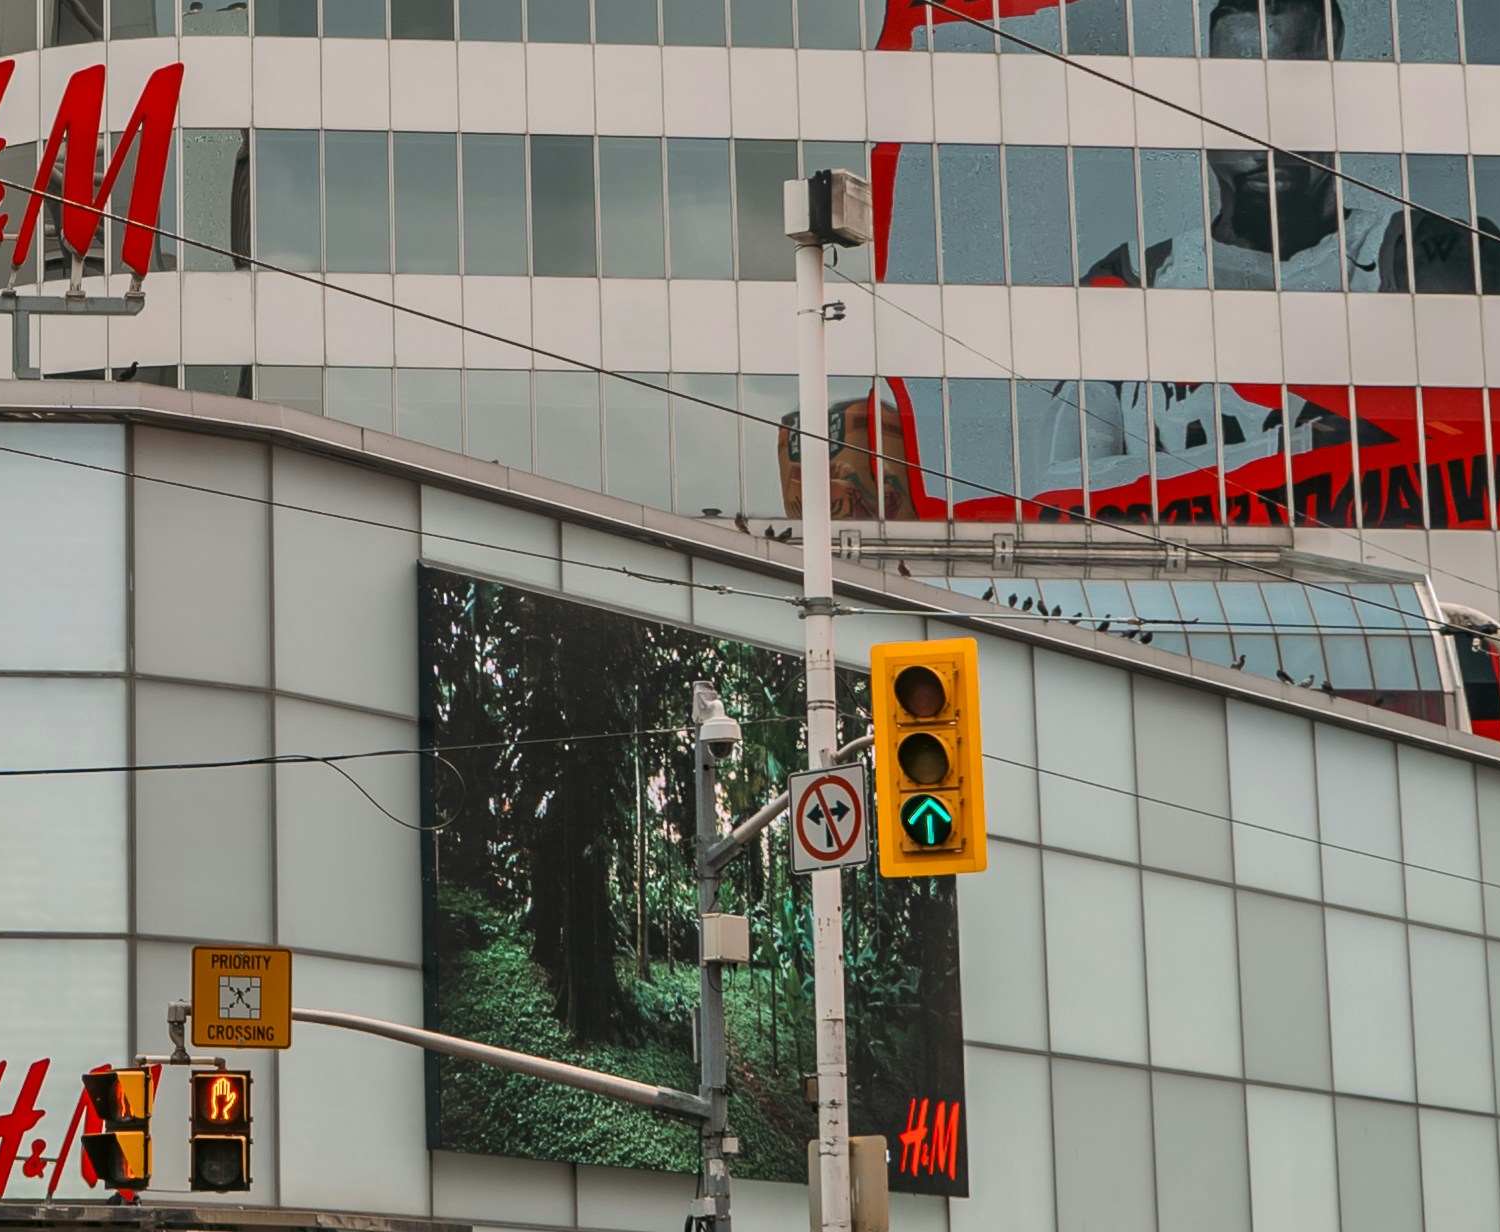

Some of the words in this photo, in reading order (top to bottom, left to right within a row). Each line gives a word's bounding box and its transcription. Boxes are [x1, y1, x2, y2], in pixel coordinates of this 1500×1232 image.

[210, 953, 272, 971] PRIORITY
[206, 1024, 276, 1042] CROSSING
[898, 1097, 961, 1182] H&M
